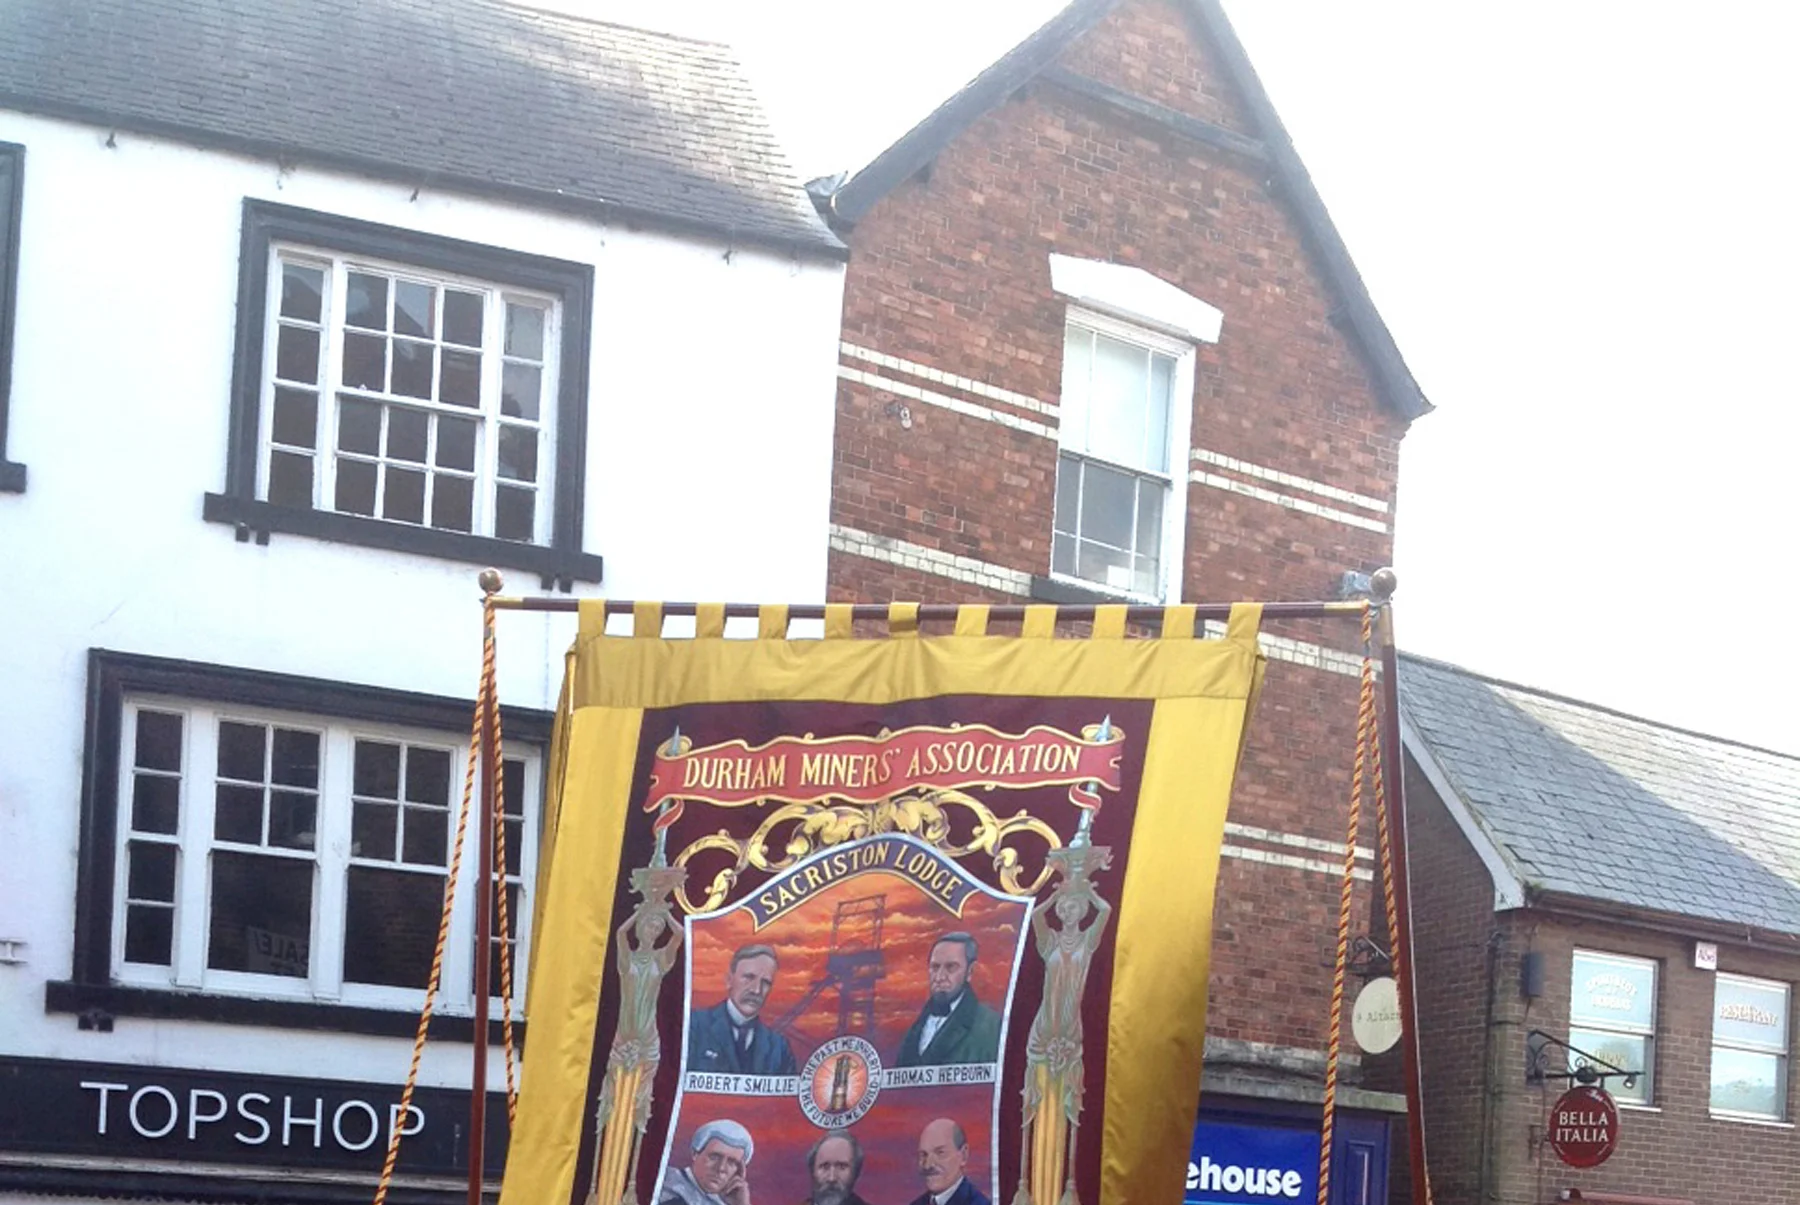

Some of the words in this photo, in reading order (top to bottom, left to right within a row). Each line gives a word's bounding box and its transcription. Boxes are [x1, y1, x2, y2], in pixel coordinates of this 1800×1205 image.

[683, 755, 786, 790] DURHAM
[800, 747, 900, 788] MINERS'
[905, 740, 1082, 779] ASSOCIATION
[760, 841, 891, 915] SACRISTON
[893, 844, 964, 900] LODGE
[814, 1040, 839, 1063] PAST
[688, 1074, 741, 1092] ROBERT
[743, 1077, 795, 1093] SMILLIE
[886, 1068, 934, 1086] THOMAS
[938, 1065, 992, 1083] HEPBURN
[806, 1105, 844, 1127] FUTURE
[858, 1080, 880, 1113] BUILD
[79, 1081, 426, 1151] TOPSHOP
[1559, 1111, 1609, 1127] BELLA
[1555, 1127, 1610, 1143] ITALIA
